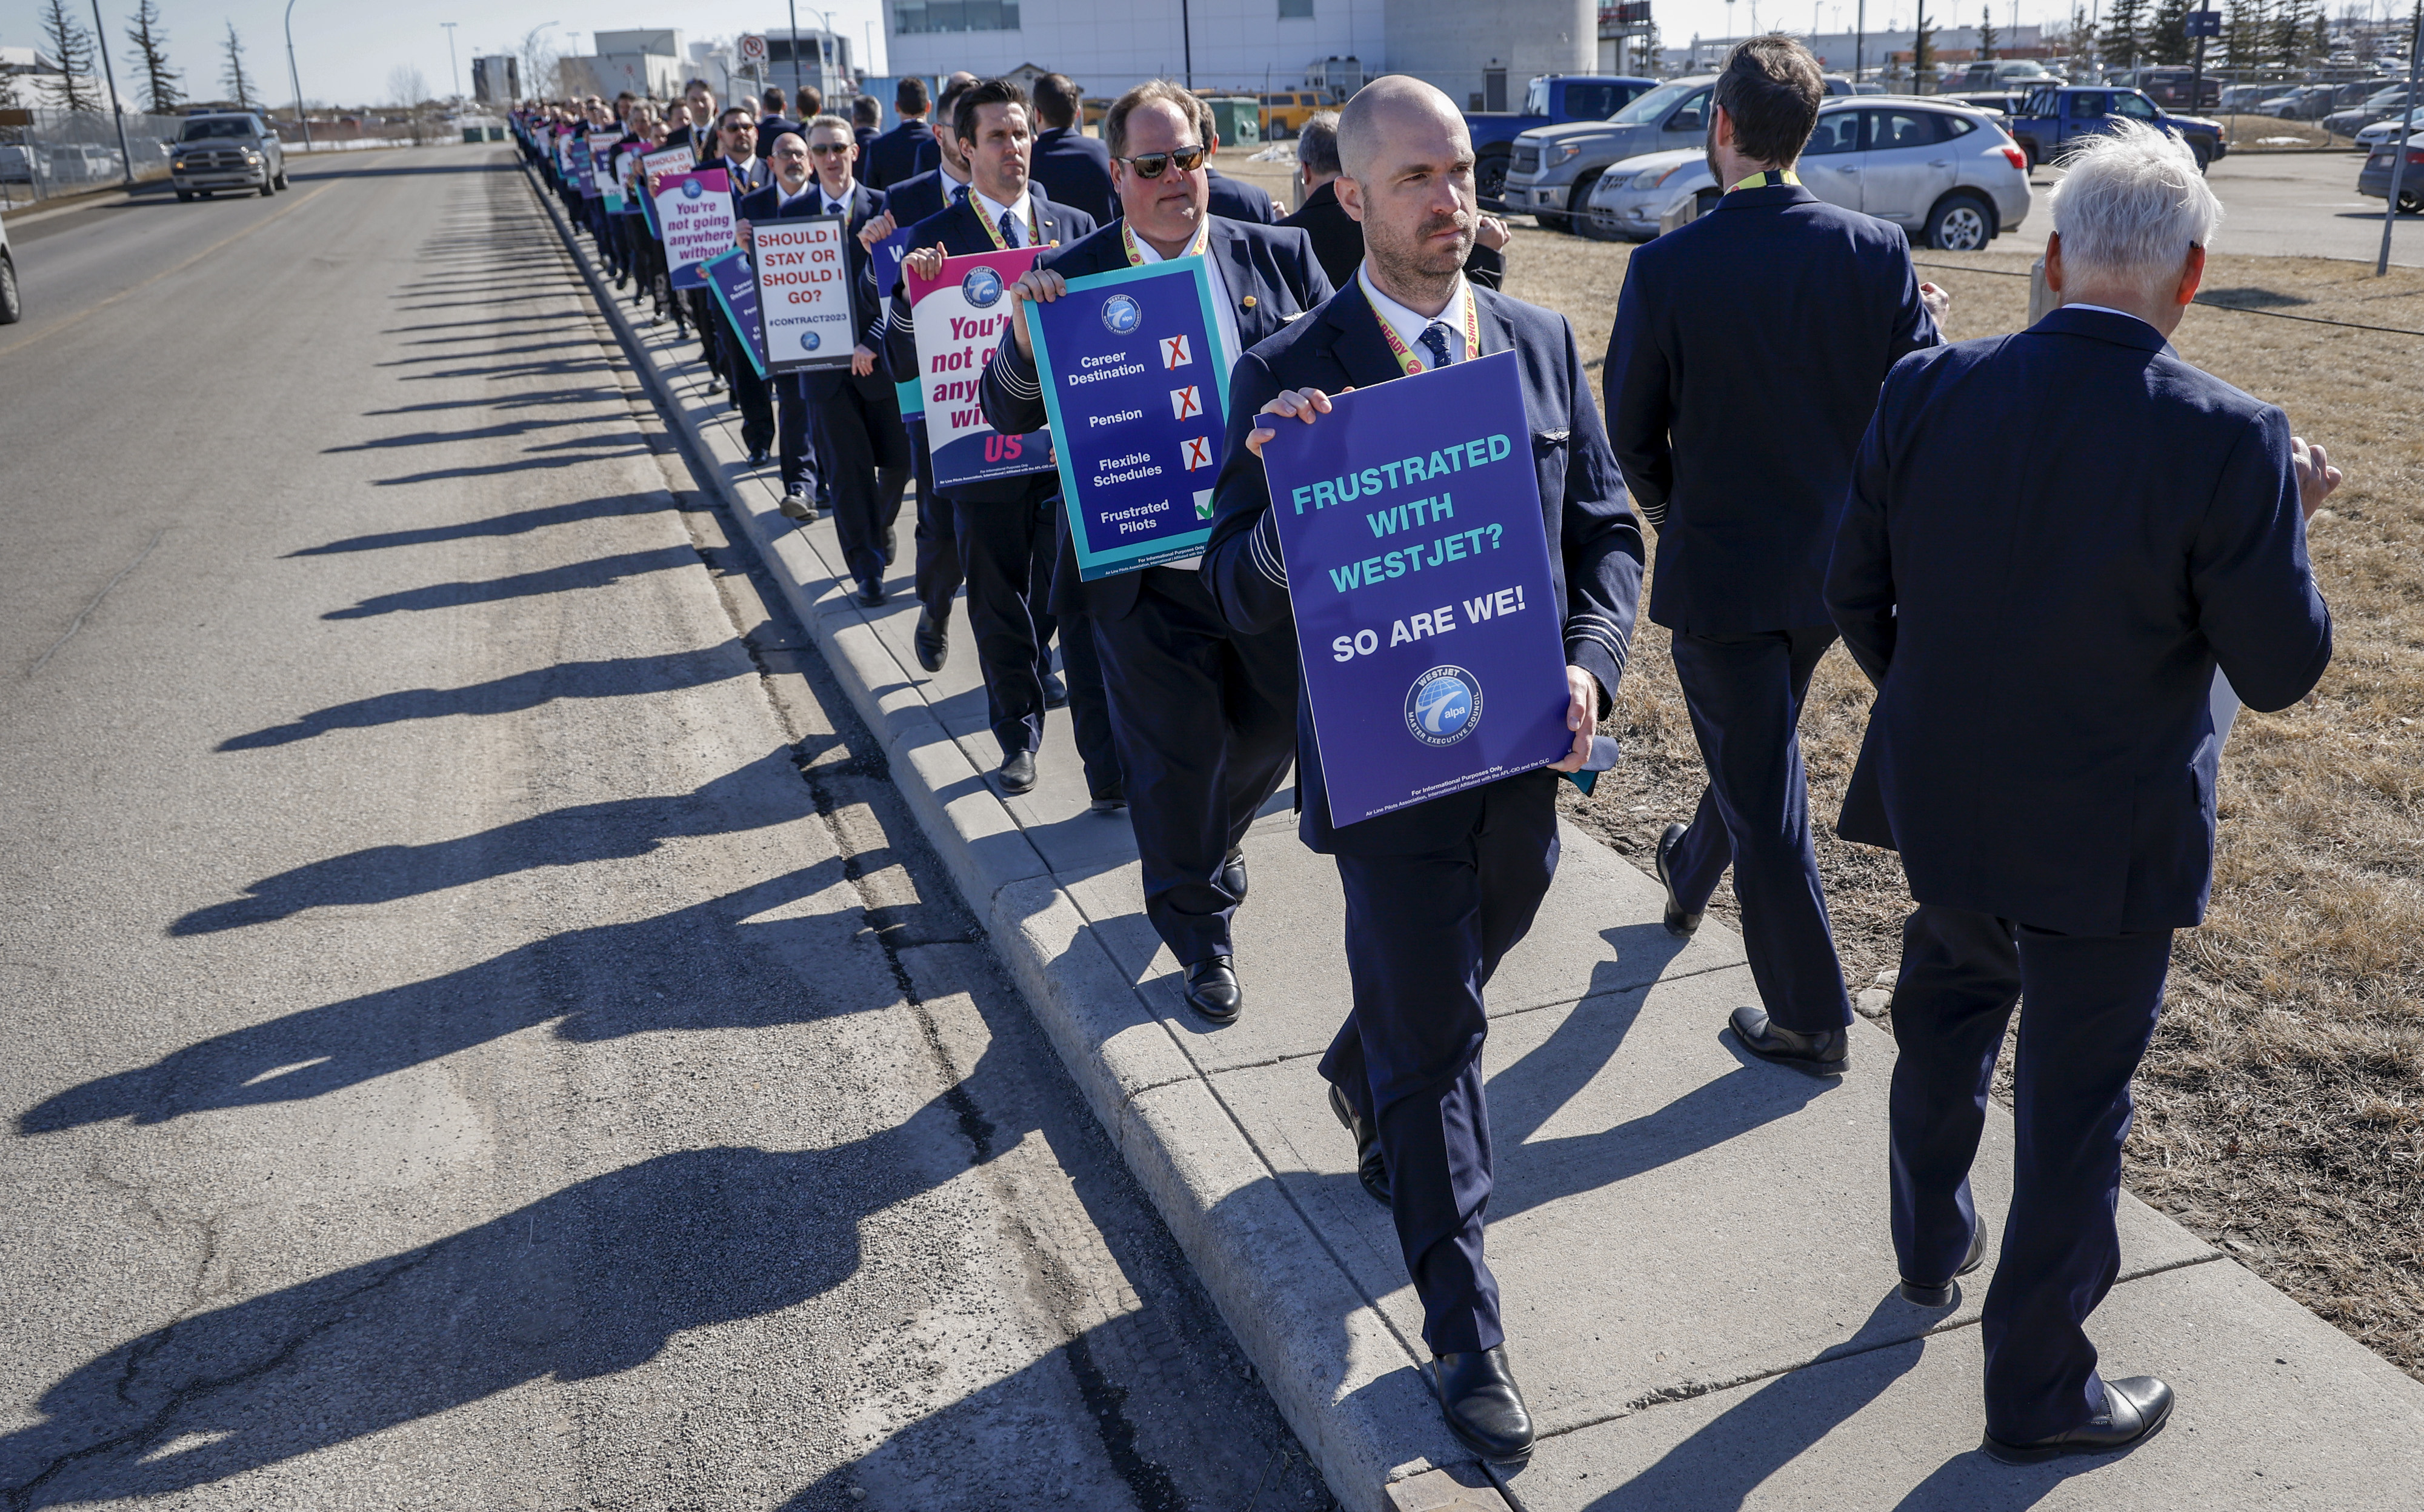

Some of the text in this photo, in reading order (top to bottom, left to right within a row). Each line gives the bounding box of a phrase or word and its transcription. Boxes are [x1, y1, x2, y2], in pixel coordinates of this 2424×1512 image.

[646, 153, 685, 168] SHOULD
[676, 202, 716, 215] You're
[668, 215, 730, 231] not going
[982, 213, 997, 233] READY
[670, 230, 733, 246] anywhere
[758, 229, 838, 247] SHOULD I
[1124, 230, 1135, 250] READY
[765, 249, 836, 267] STAY OR
[762, 268, 842, 287] SHOULD I
[788, 290, 822, 304] GO?
[1108, 296, 1129, 305] WESTJET
[1467, 296, 1474, 310] US
[769, 313, 847, 327] #CONTRACT2023
[1104, 315, 1114, 330] MASTER
[1467, 311, 1476, 344] SHOW
[1380, 323, 1408, 356] READY
[931, 346, 973, 373] not
[1081, 351, 1127, 368] Career
[1068, 364, 1145, 386] Destination
[1089, 409, 1143, 428] Pension
[984, 433, 1024, 462] US
[1099, 452, 1151, 471] Flexible
[1093, 465, 1162, 487] Schedules
[1291, 433, 1511, 516] FRUSTRATED
[1100, 499, 1170, 524] Frustrated
[1366, 492, 1454, 539] WITH
[1119, 518, 1157, 535] Pilots
[1146, 552, 1174, 561] Informational
[1174, 547, 1194, 556] Purposes
[1328, 523, 1503, 594] WESTJET?
[1333, 585, 1527, 662] SO ARE WE!
[1418, 668, 1460, 687] WESTJET
[1408, 691, 1480, 744] MASTER EXECUTIVE COUNCIL
[1444, 707, 1465, 719] alpa
[1399, 795, 1428, 807] Association,
[1428, 785, 1457, 798] International
[1460, 779, 1480, 788] Affiliated
[1500, 767, 1520, 776] AFL-CIO
[1422, 777, 1460, 793] Informational
[1461, 770, 1489, 781] Purposes
